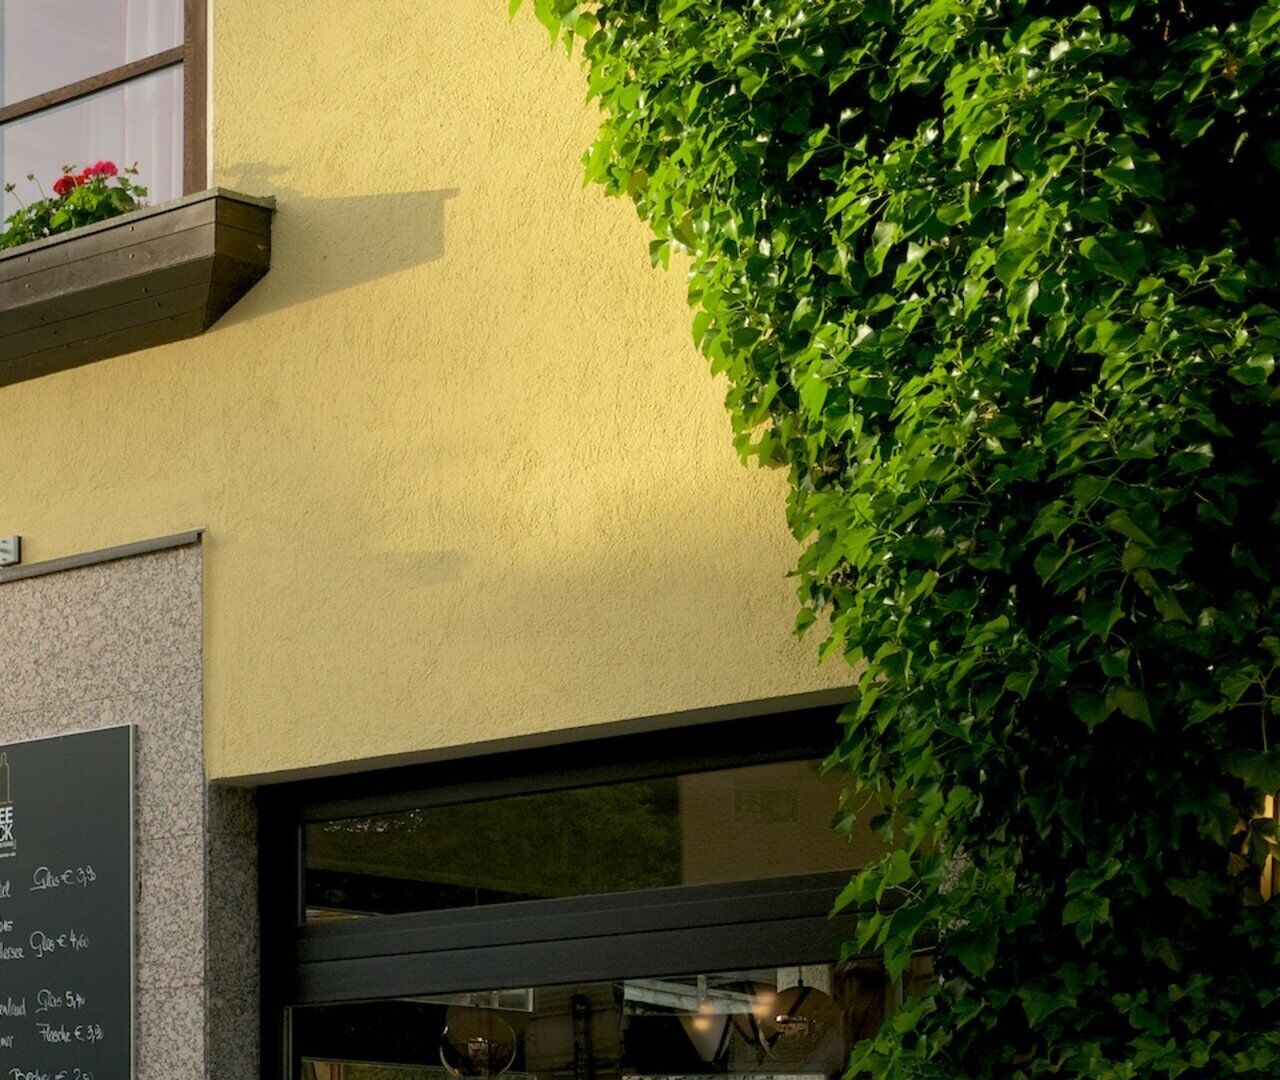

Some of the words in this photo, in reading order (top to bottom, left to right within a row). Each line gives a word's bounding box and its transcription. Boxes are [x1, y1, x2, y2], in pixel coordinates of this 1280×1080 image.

[30, 866, 60, 891] Glas
[29, 930, 56, 958] Glas
[74, 1025, 85, 1041] €
